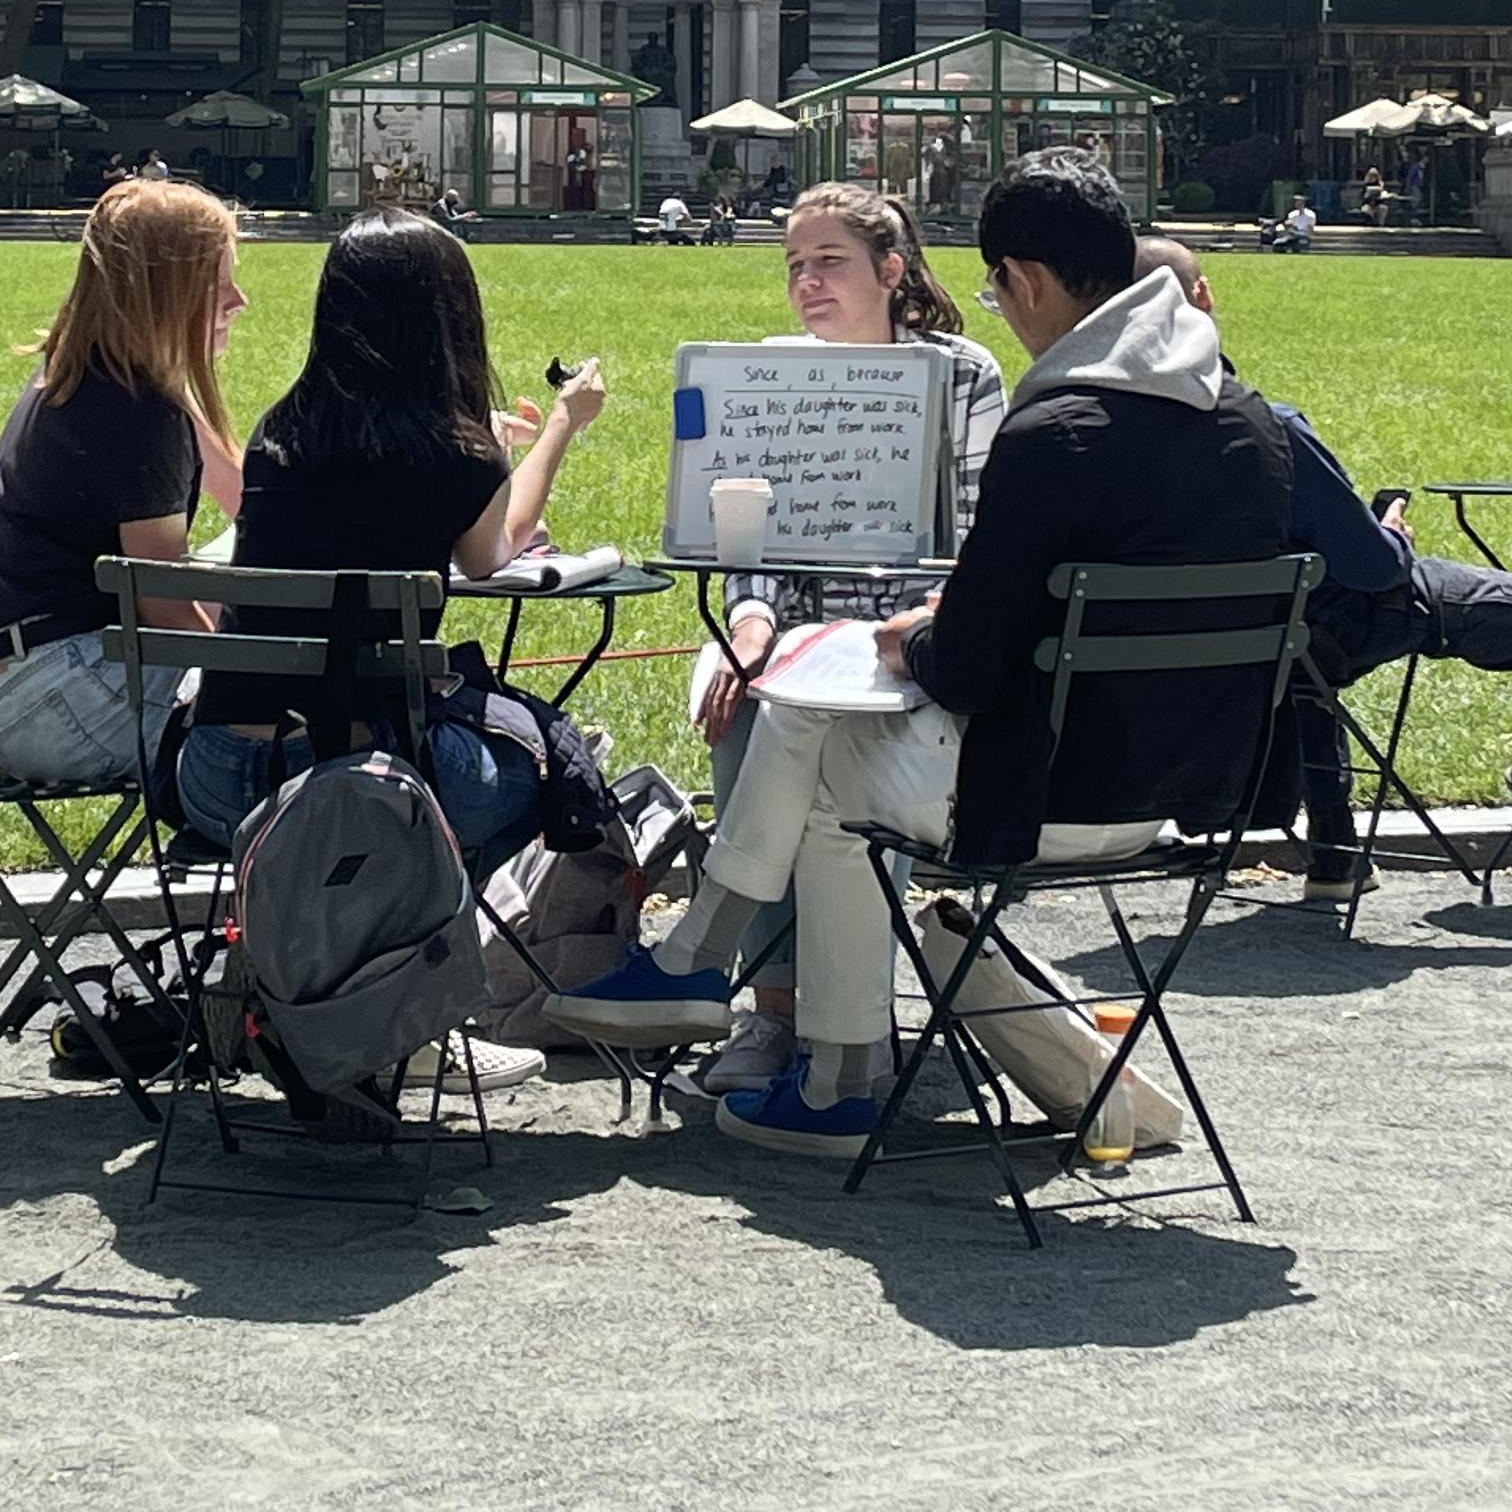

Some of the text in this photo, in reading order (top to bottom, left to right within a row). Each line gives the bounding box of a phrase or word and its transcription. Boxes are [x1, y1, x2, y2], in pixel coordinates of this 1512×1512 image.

[847, 365, 904, 382] because
[723, 398, 760, 420] Since
[793, 396, 857, 420] daughter
[744, 417, 793, 443] stayed
[796, 419, 825, 436] home
[836, 417, 864, 435] from
[758, 447, 817, 475] daughter
[891, 446, 910, 461] he
[800, 469, 826, 486] from
[789, 497, 820, 516] home
[830, 491, 857, 512] from
[801, 518, 853, 542] daughter
